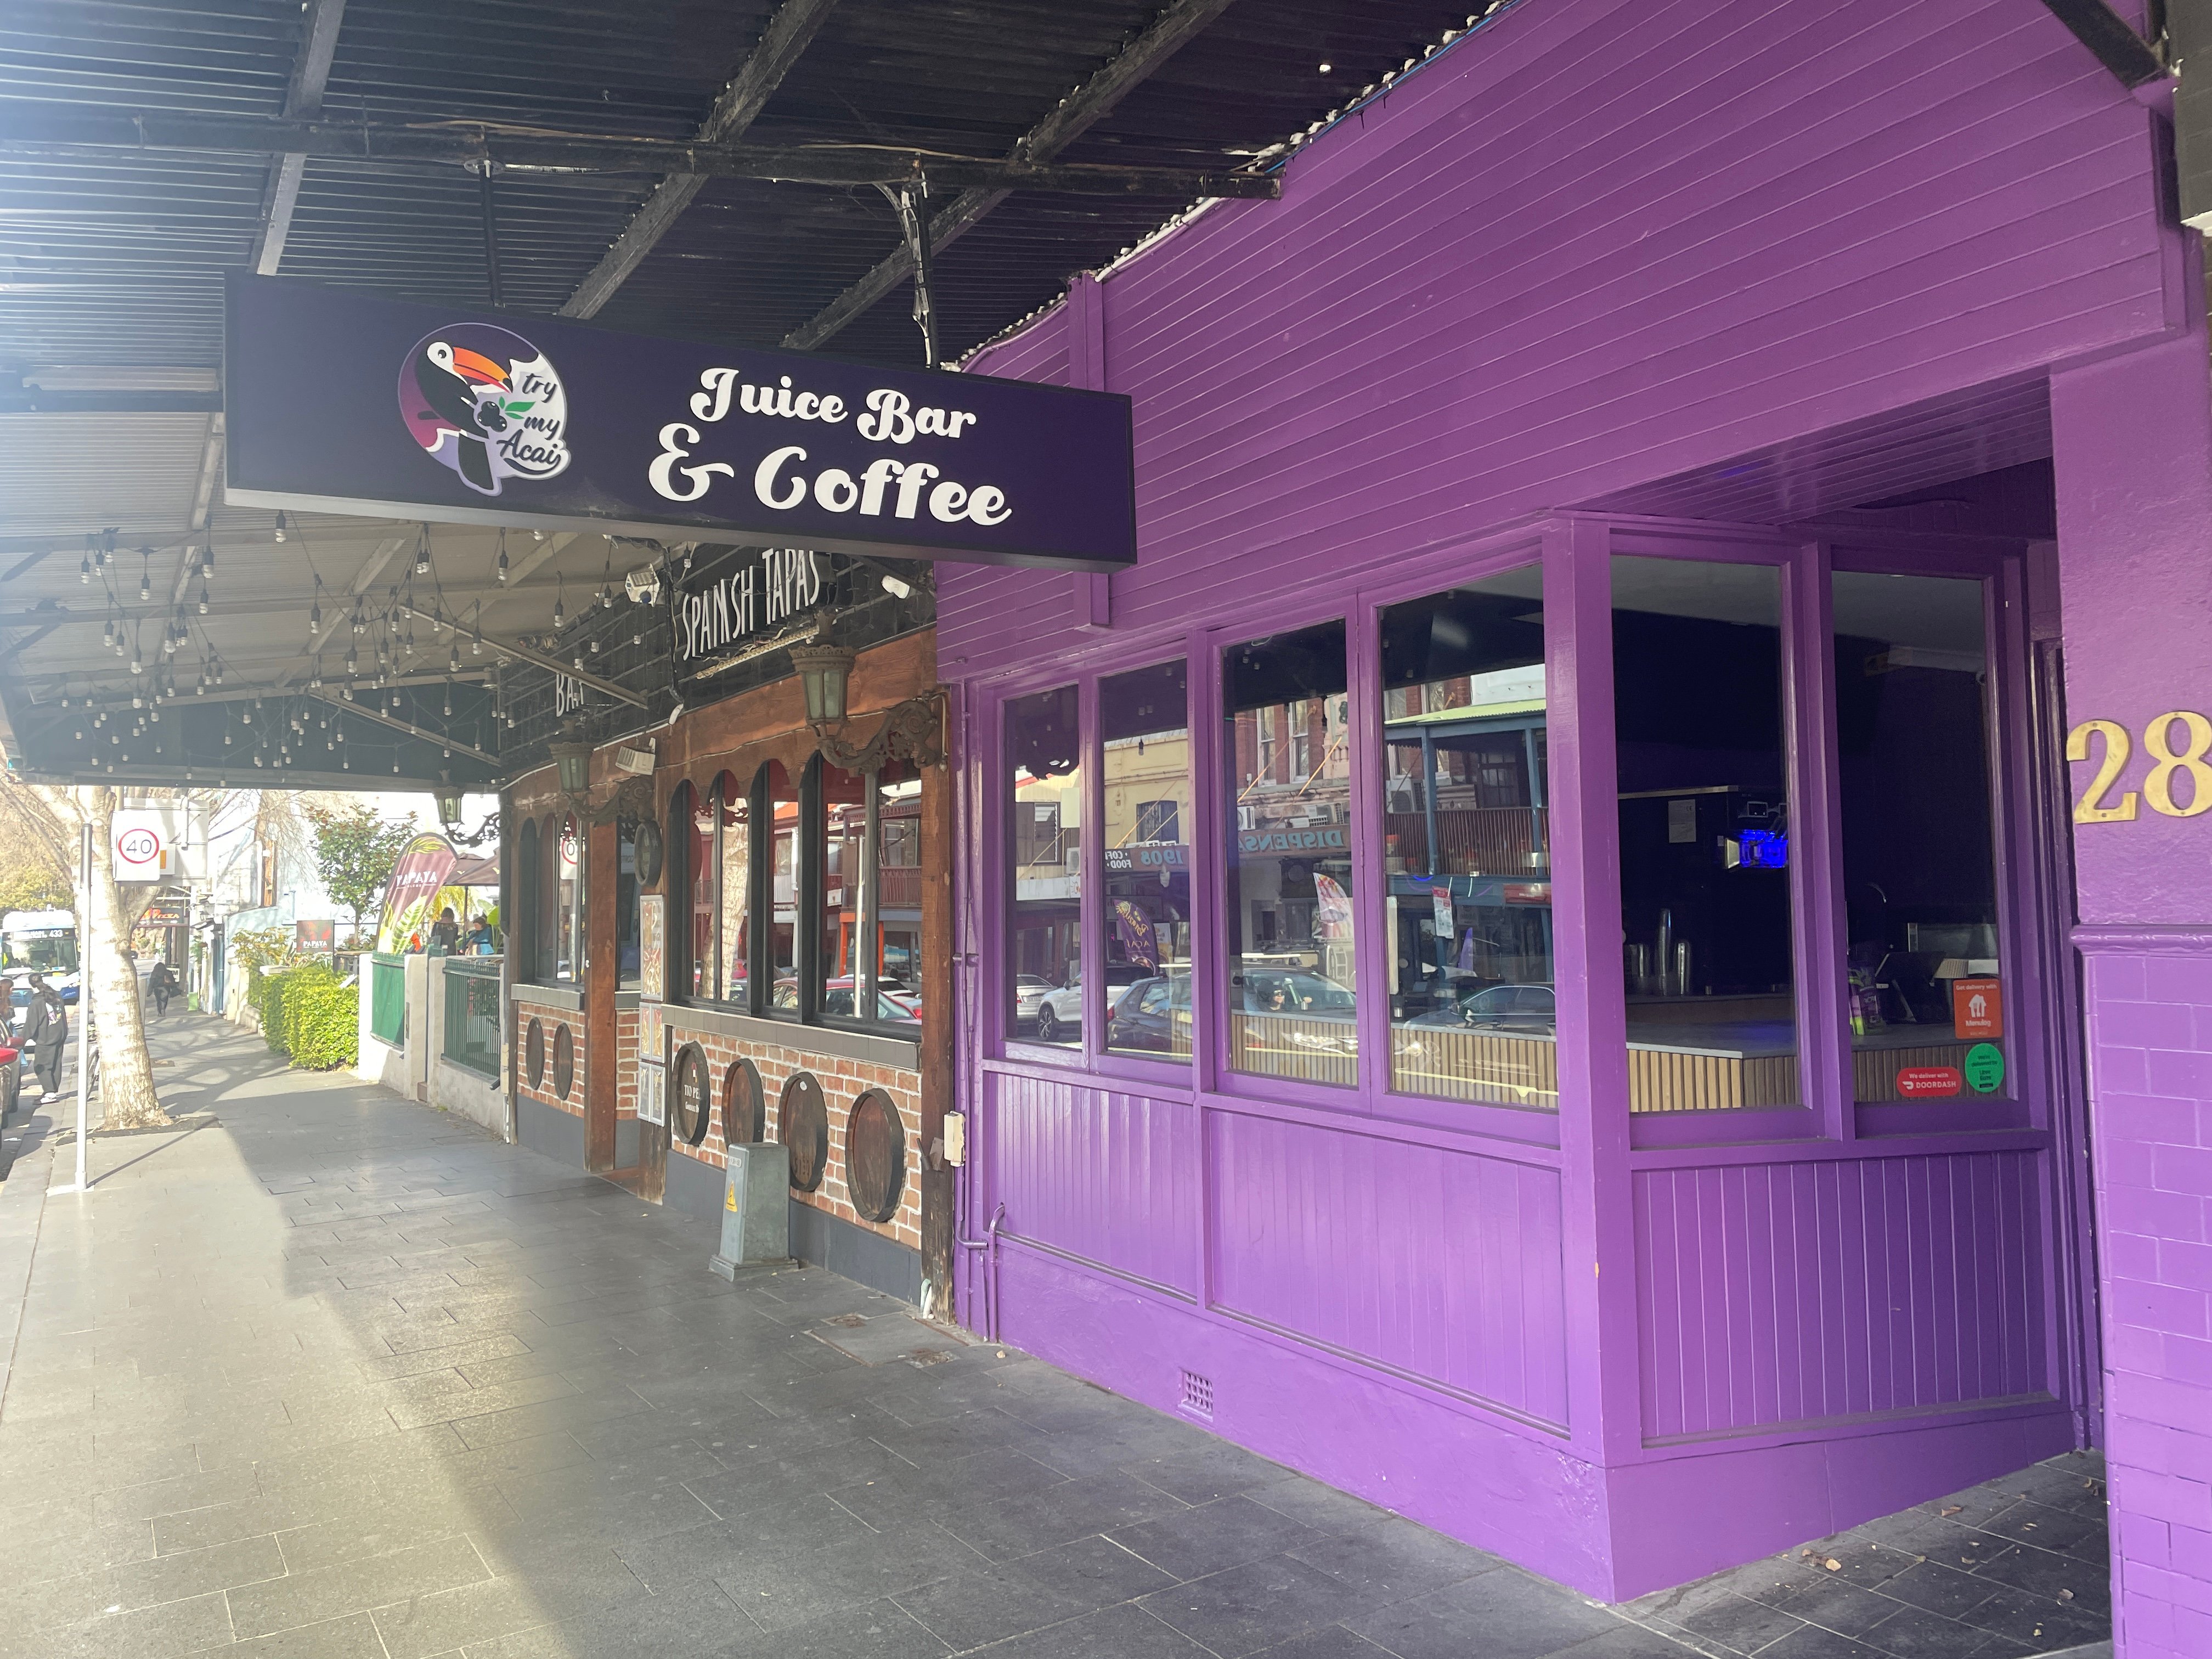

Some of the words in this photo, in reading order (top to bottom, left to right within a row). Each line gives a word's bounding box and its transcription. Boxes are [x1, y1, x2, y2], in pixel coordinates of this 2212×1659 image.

[522, 373, 557, 403] try
[690, 368, 848, 422] Juice
[856, 389, 977, 444] Bar
[524, 416, 560, 441] my
[496, 428, 561, 466] Acai
[648, 422, 735, 501] &
[754, 446, 1012, 526] Coffee
[762, 548, 820, 625] TAPAS
[2066, 711, 2212, 824] 28
[126, 839, 152, 854] 40
[397, 871, 437, 887] PAPAYA
[49, 929, 63, 938] 433
[1916, 1080, 1956, 1089] DOORDASH
